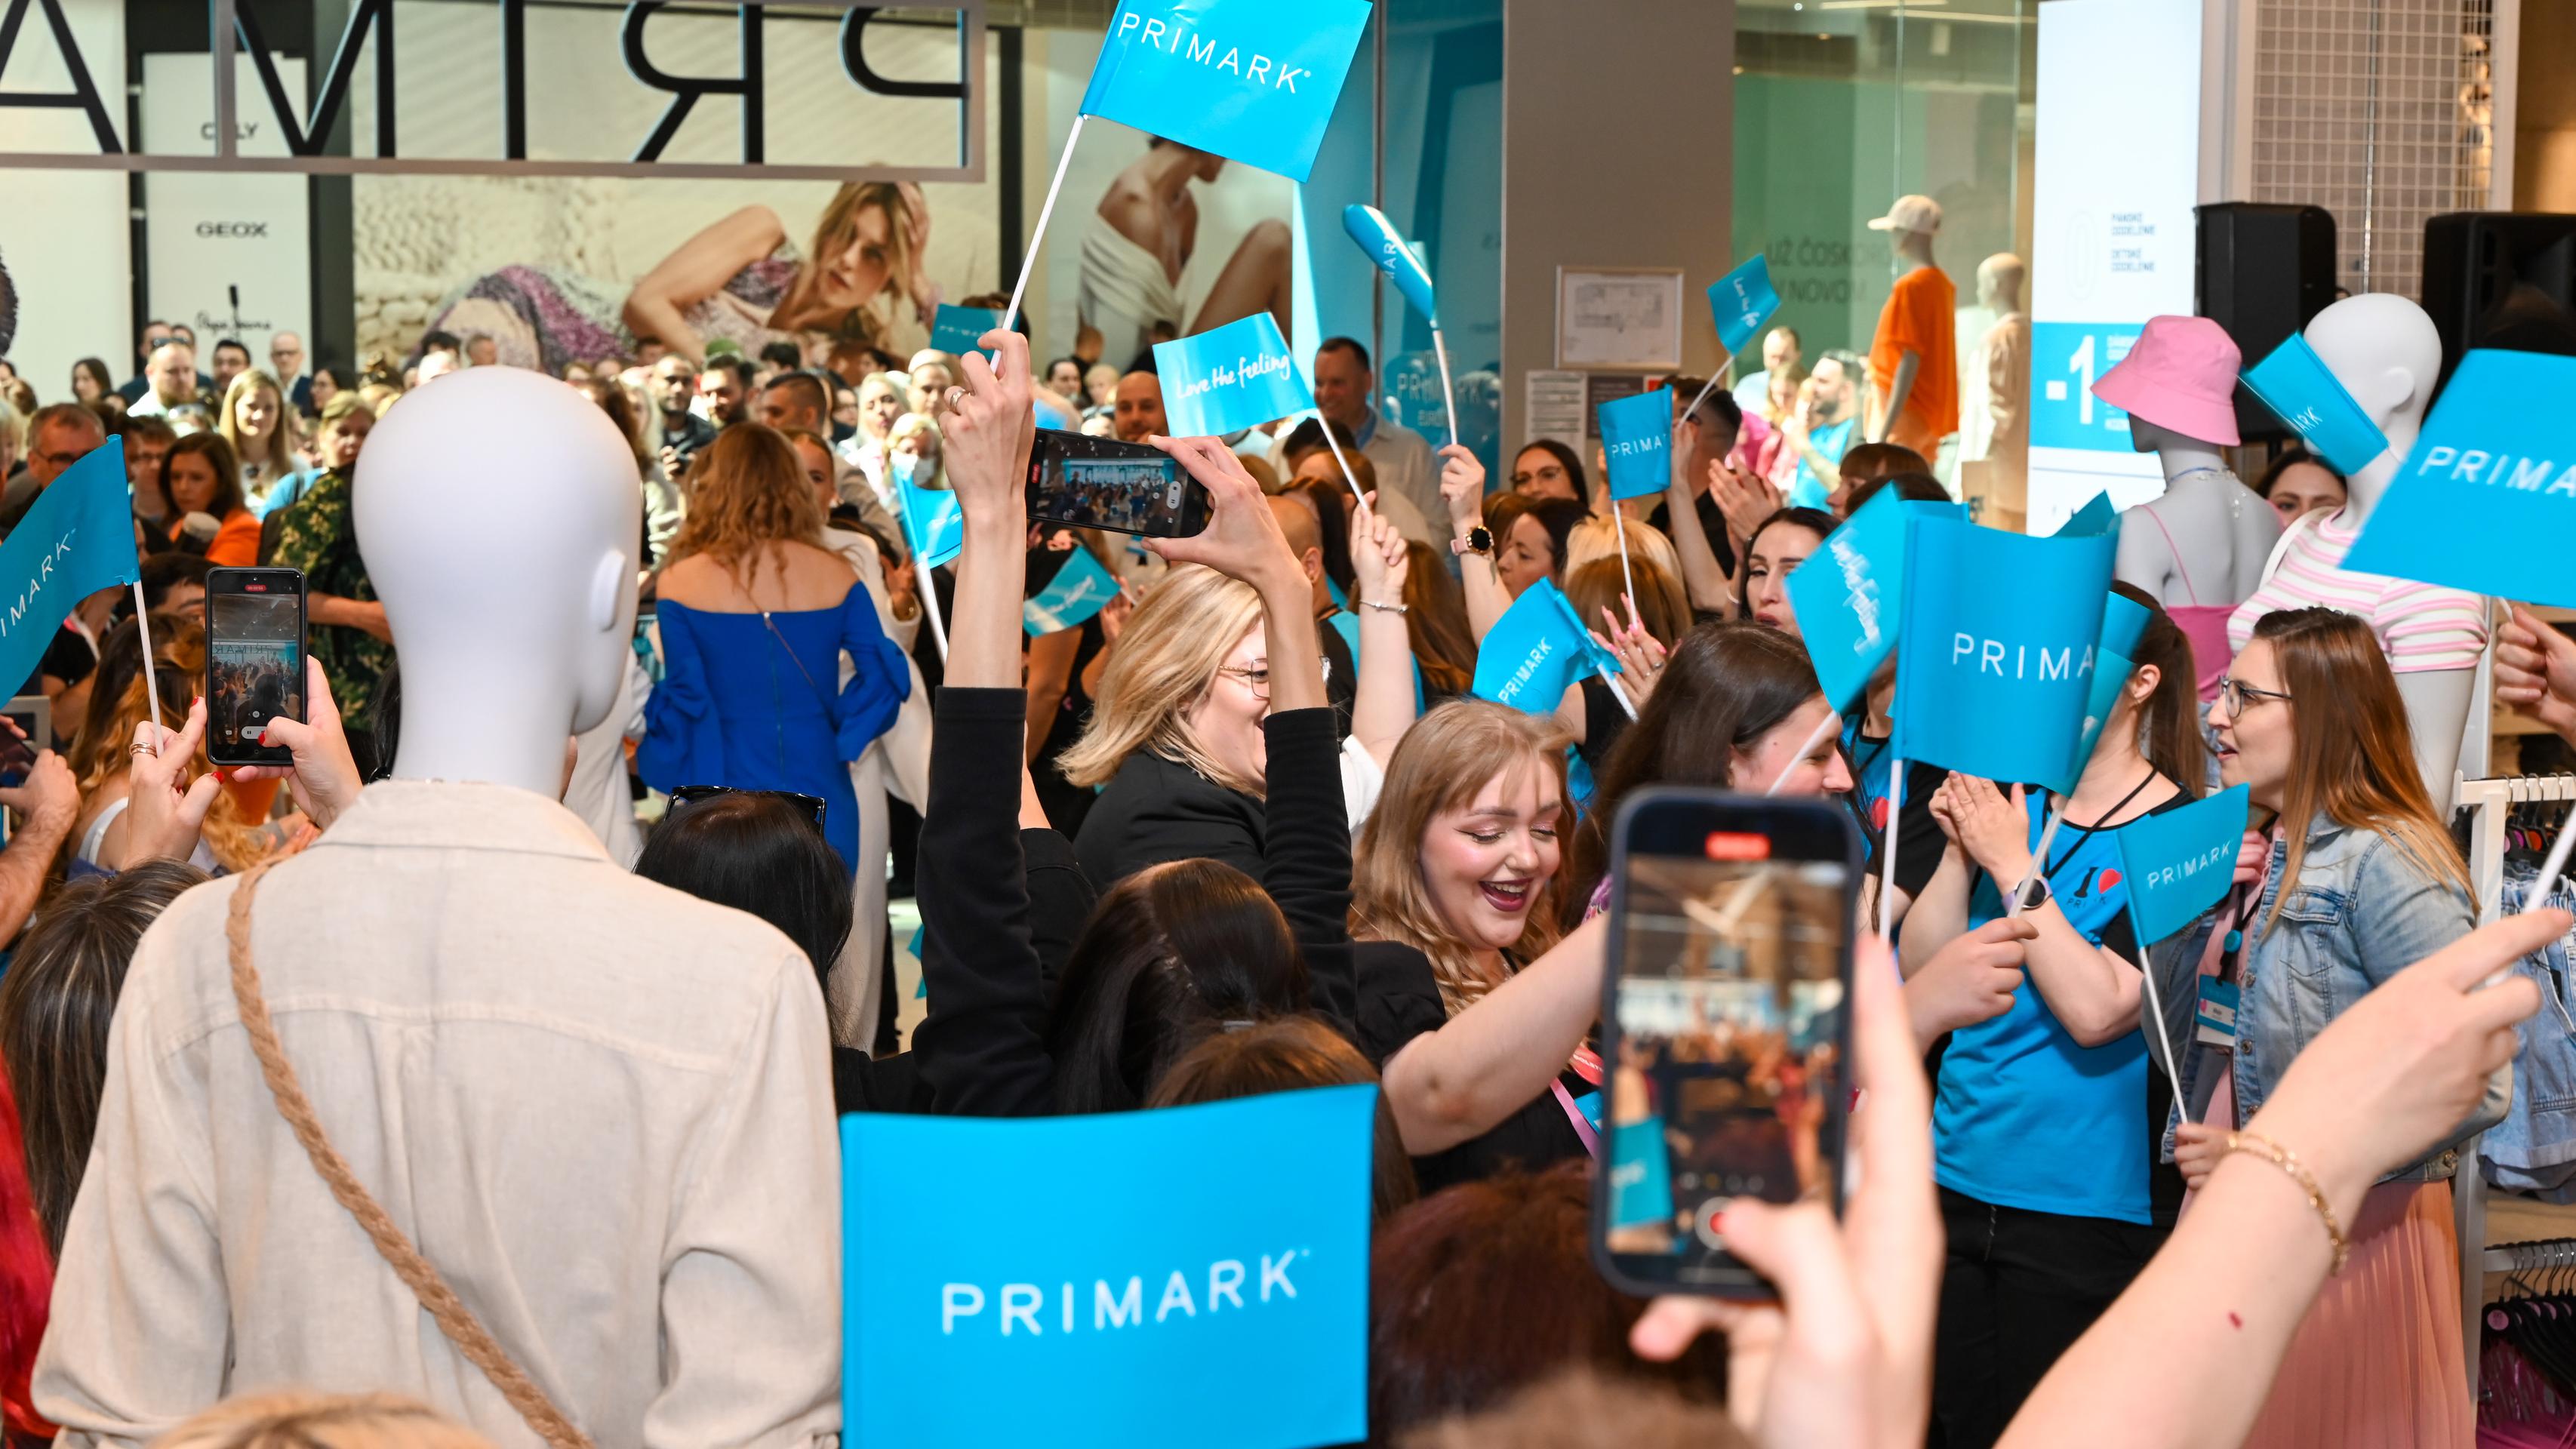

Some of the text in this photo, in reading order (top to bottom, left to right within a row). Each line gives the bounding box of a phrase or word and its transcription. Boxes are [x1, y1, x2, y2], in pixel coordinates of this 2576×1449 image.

[195, 222, 268, 238] GEOX
[1176, 352, 1291, 399] Love the feeling
[1497, 636, 1553, 706] PRIMARK
[2146, 840, 2230, 890] PRIMARK
[940, 1249, 1300, 1337] PRIMARK
